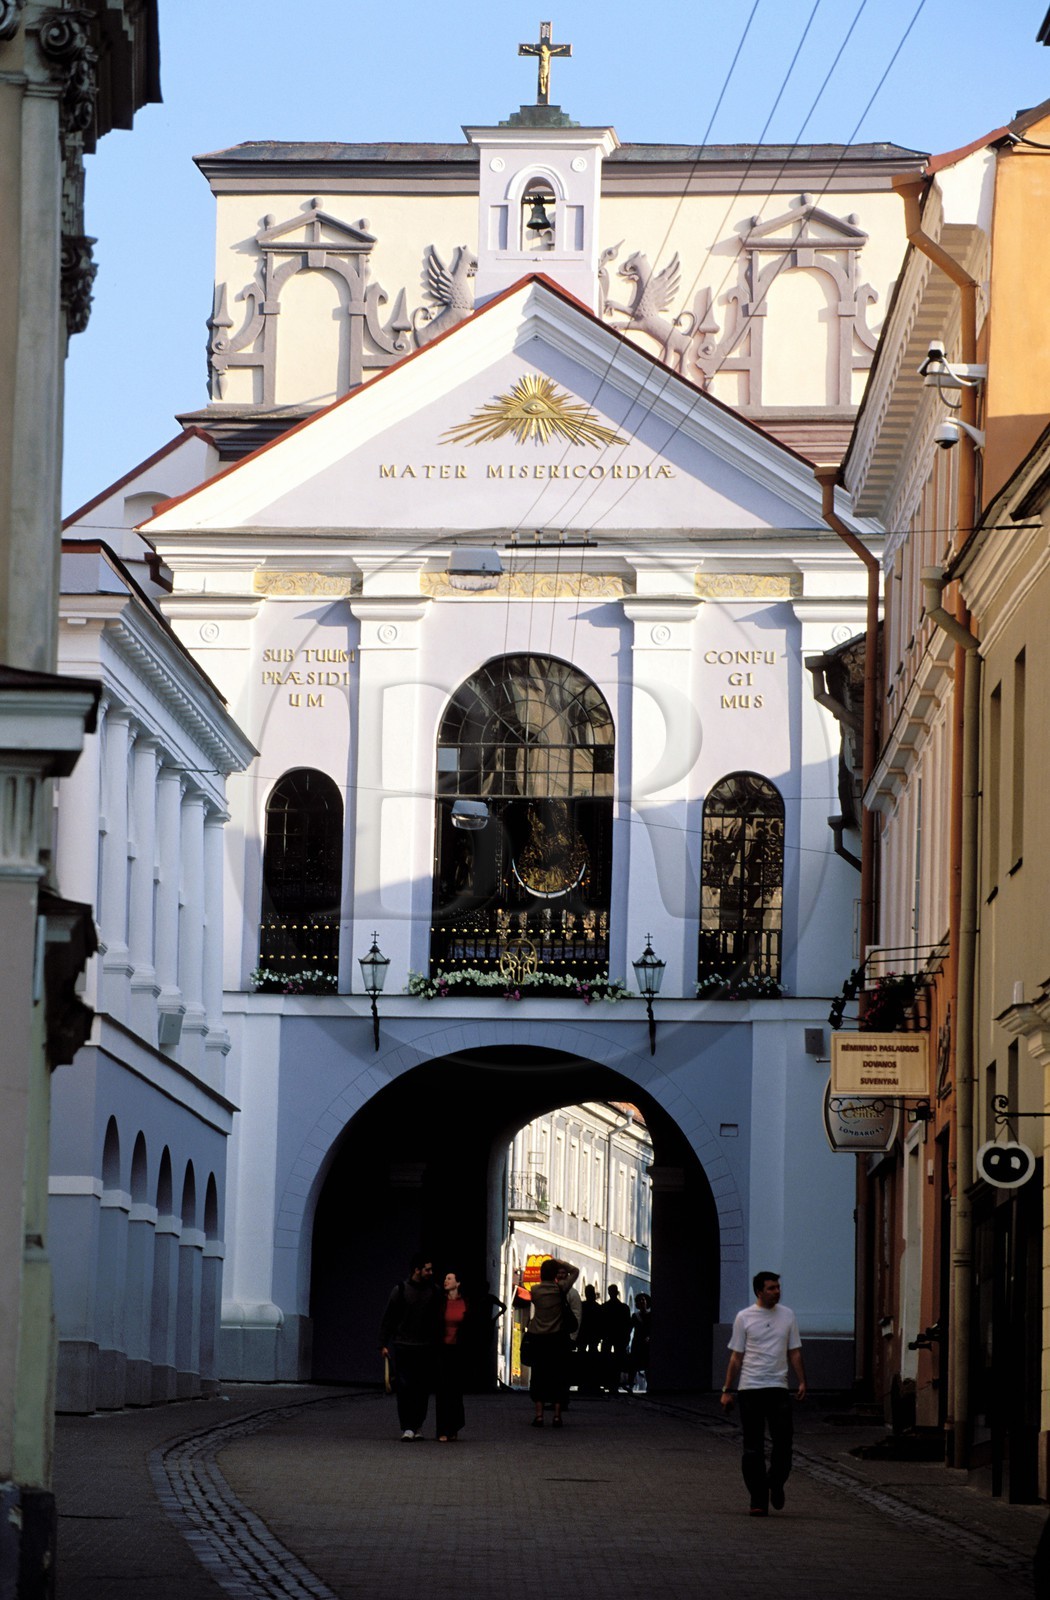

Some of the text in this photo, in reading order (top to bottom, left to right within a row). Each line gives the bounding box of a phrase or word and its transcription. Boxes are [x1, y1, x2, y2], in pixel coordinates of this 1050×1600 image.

[379, 464, 677, 479] MATER MISERICORDIÆ
[262, 648, 355, 663] SUB TUUM
[703, 650, 777, 665] CONFU
[261, 671, 350, 685] PRÆSIDI
[728, 672, 753, 686] GI
[288, 693, 325, 707] UM
[720, 695, 764, 709] MUS
[879, 1044, 920, 1053] PASLAUGOS
[862, 1060, 897, 1068] DOVANOS
[860, 1077, 899, 1085] SUVENYRAI
[838, 1126, 884, 1137] LOMBARDAS
